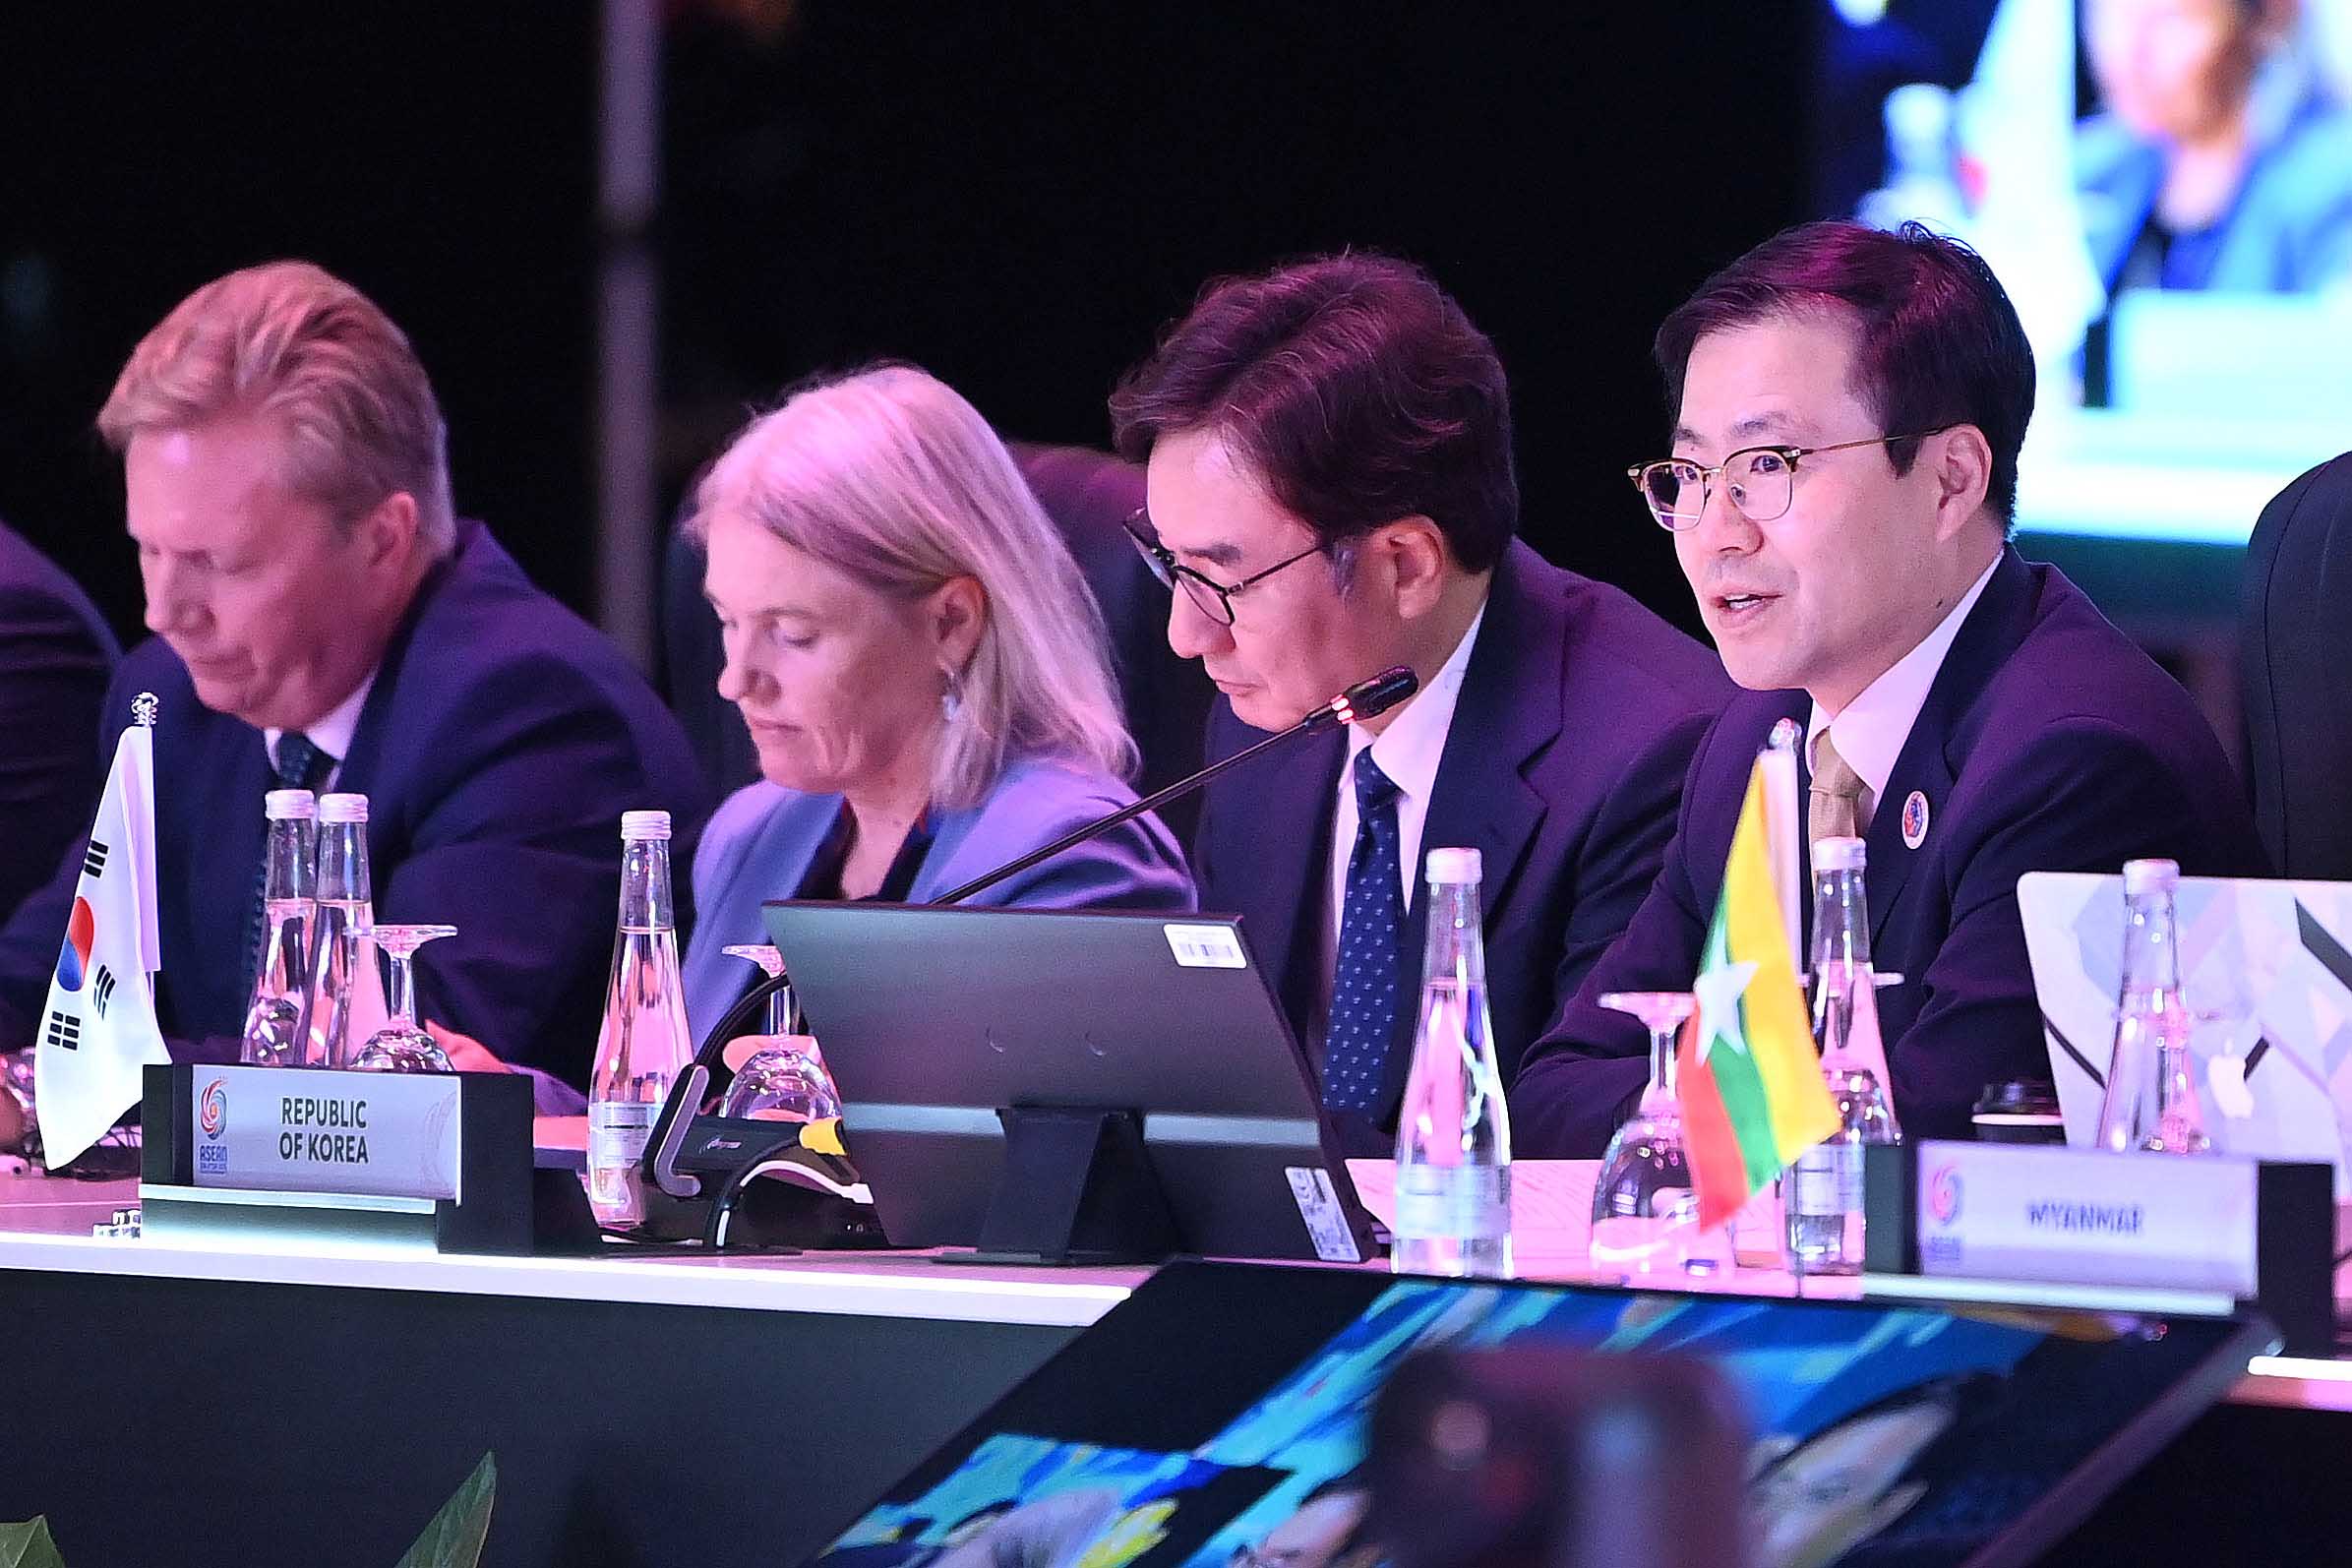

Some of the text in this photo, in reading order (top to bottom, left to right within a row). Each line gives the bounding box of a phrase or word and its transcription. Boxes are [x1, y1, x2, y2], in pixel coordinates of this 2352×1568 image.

[281, 1097, 367, 1128] REPUBLIC
[279, 1131, 369, 1164] OF KOREA
